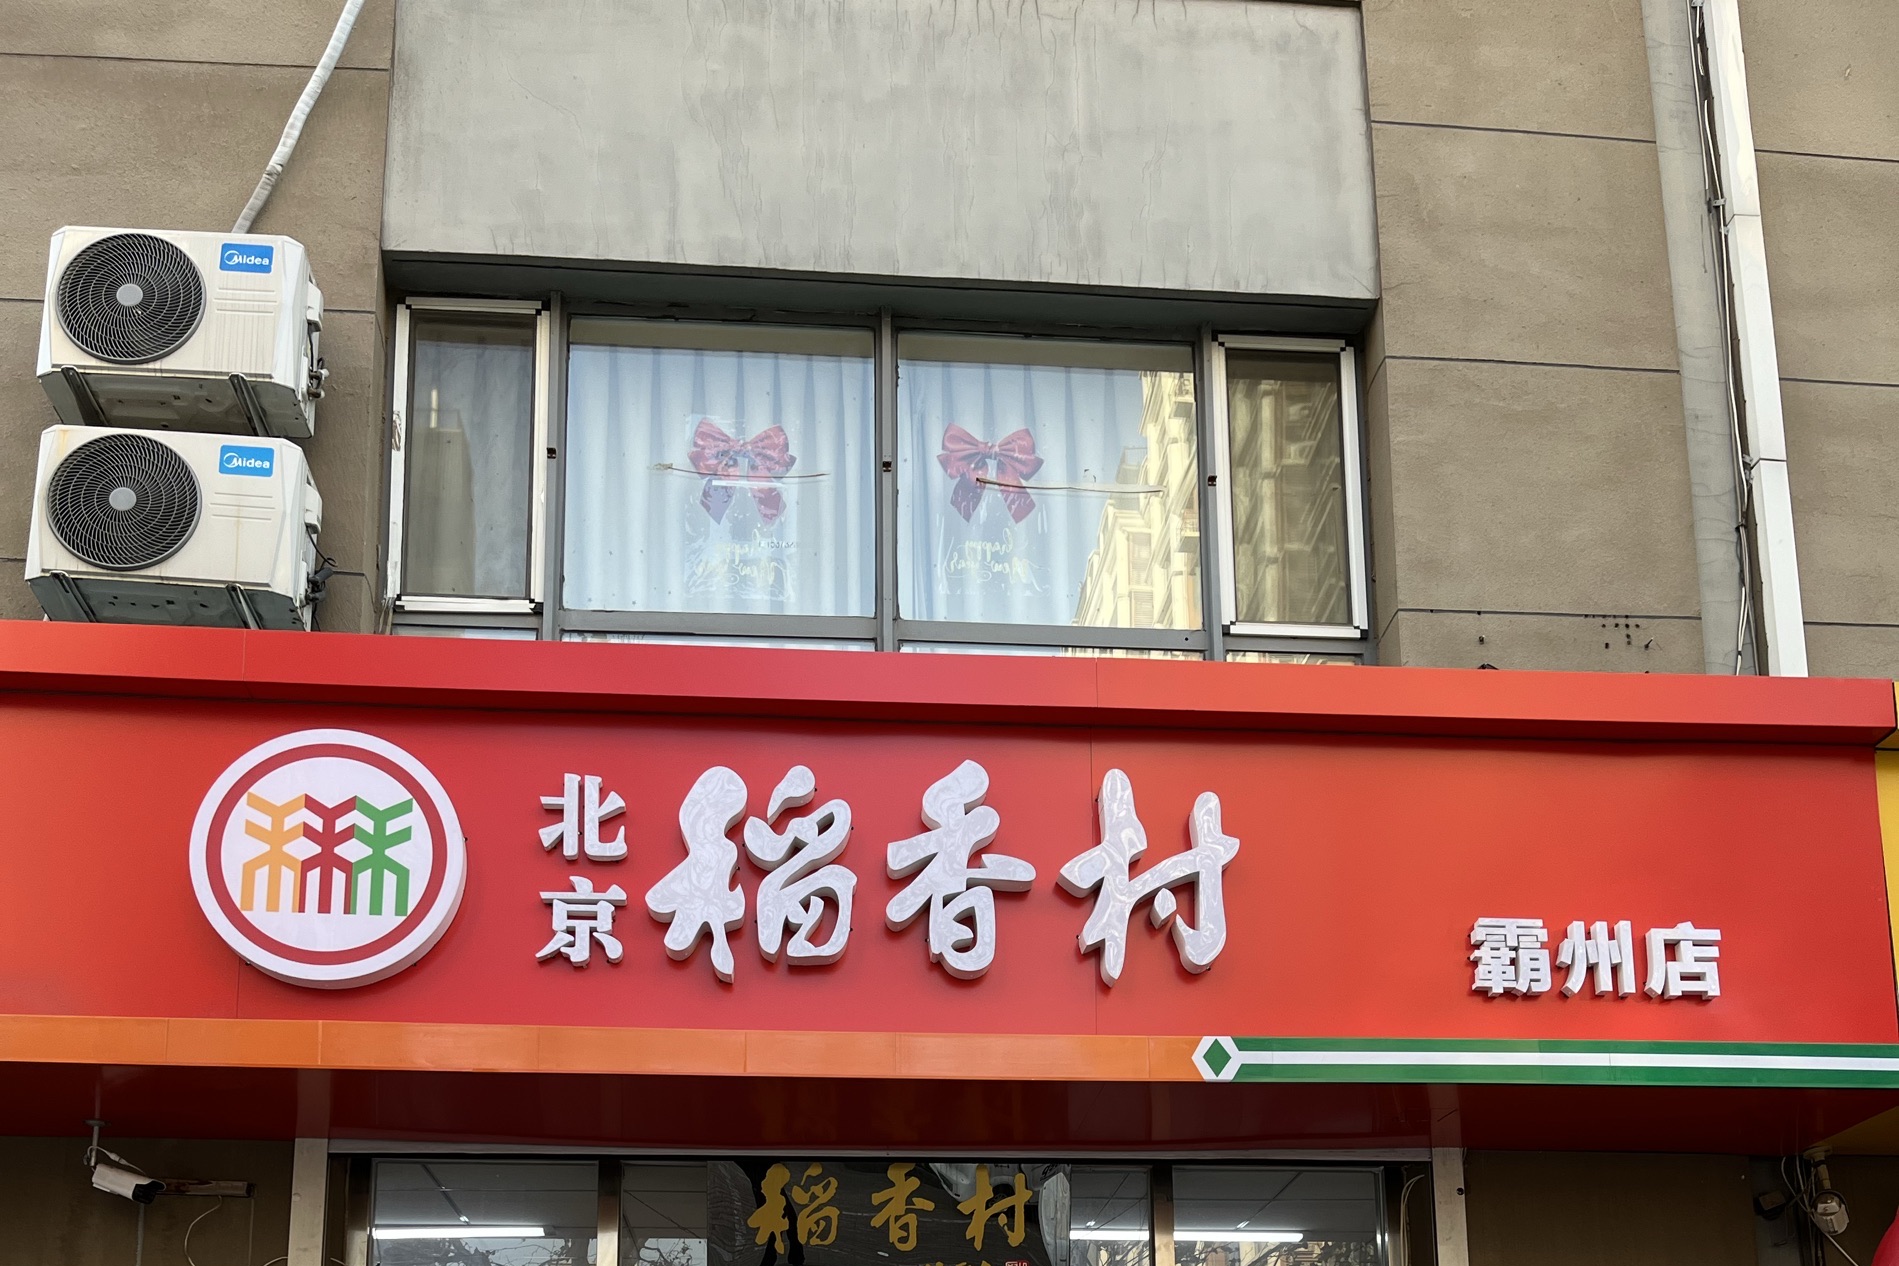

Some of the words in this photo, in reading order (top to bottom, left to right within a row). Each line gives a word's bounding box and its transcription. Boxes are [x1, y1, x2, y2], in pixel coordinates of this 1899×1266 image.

[224, 250, 270, 266] Midea
[223, 452, 270, 468] Midea
[535, 772, 628, 968] 北京
[643, 759, 1240, 987] 稻香村
[1470, 917, 1721, 1000] 霸州店
[746, 1162, 1033, 1255] 稻香村
